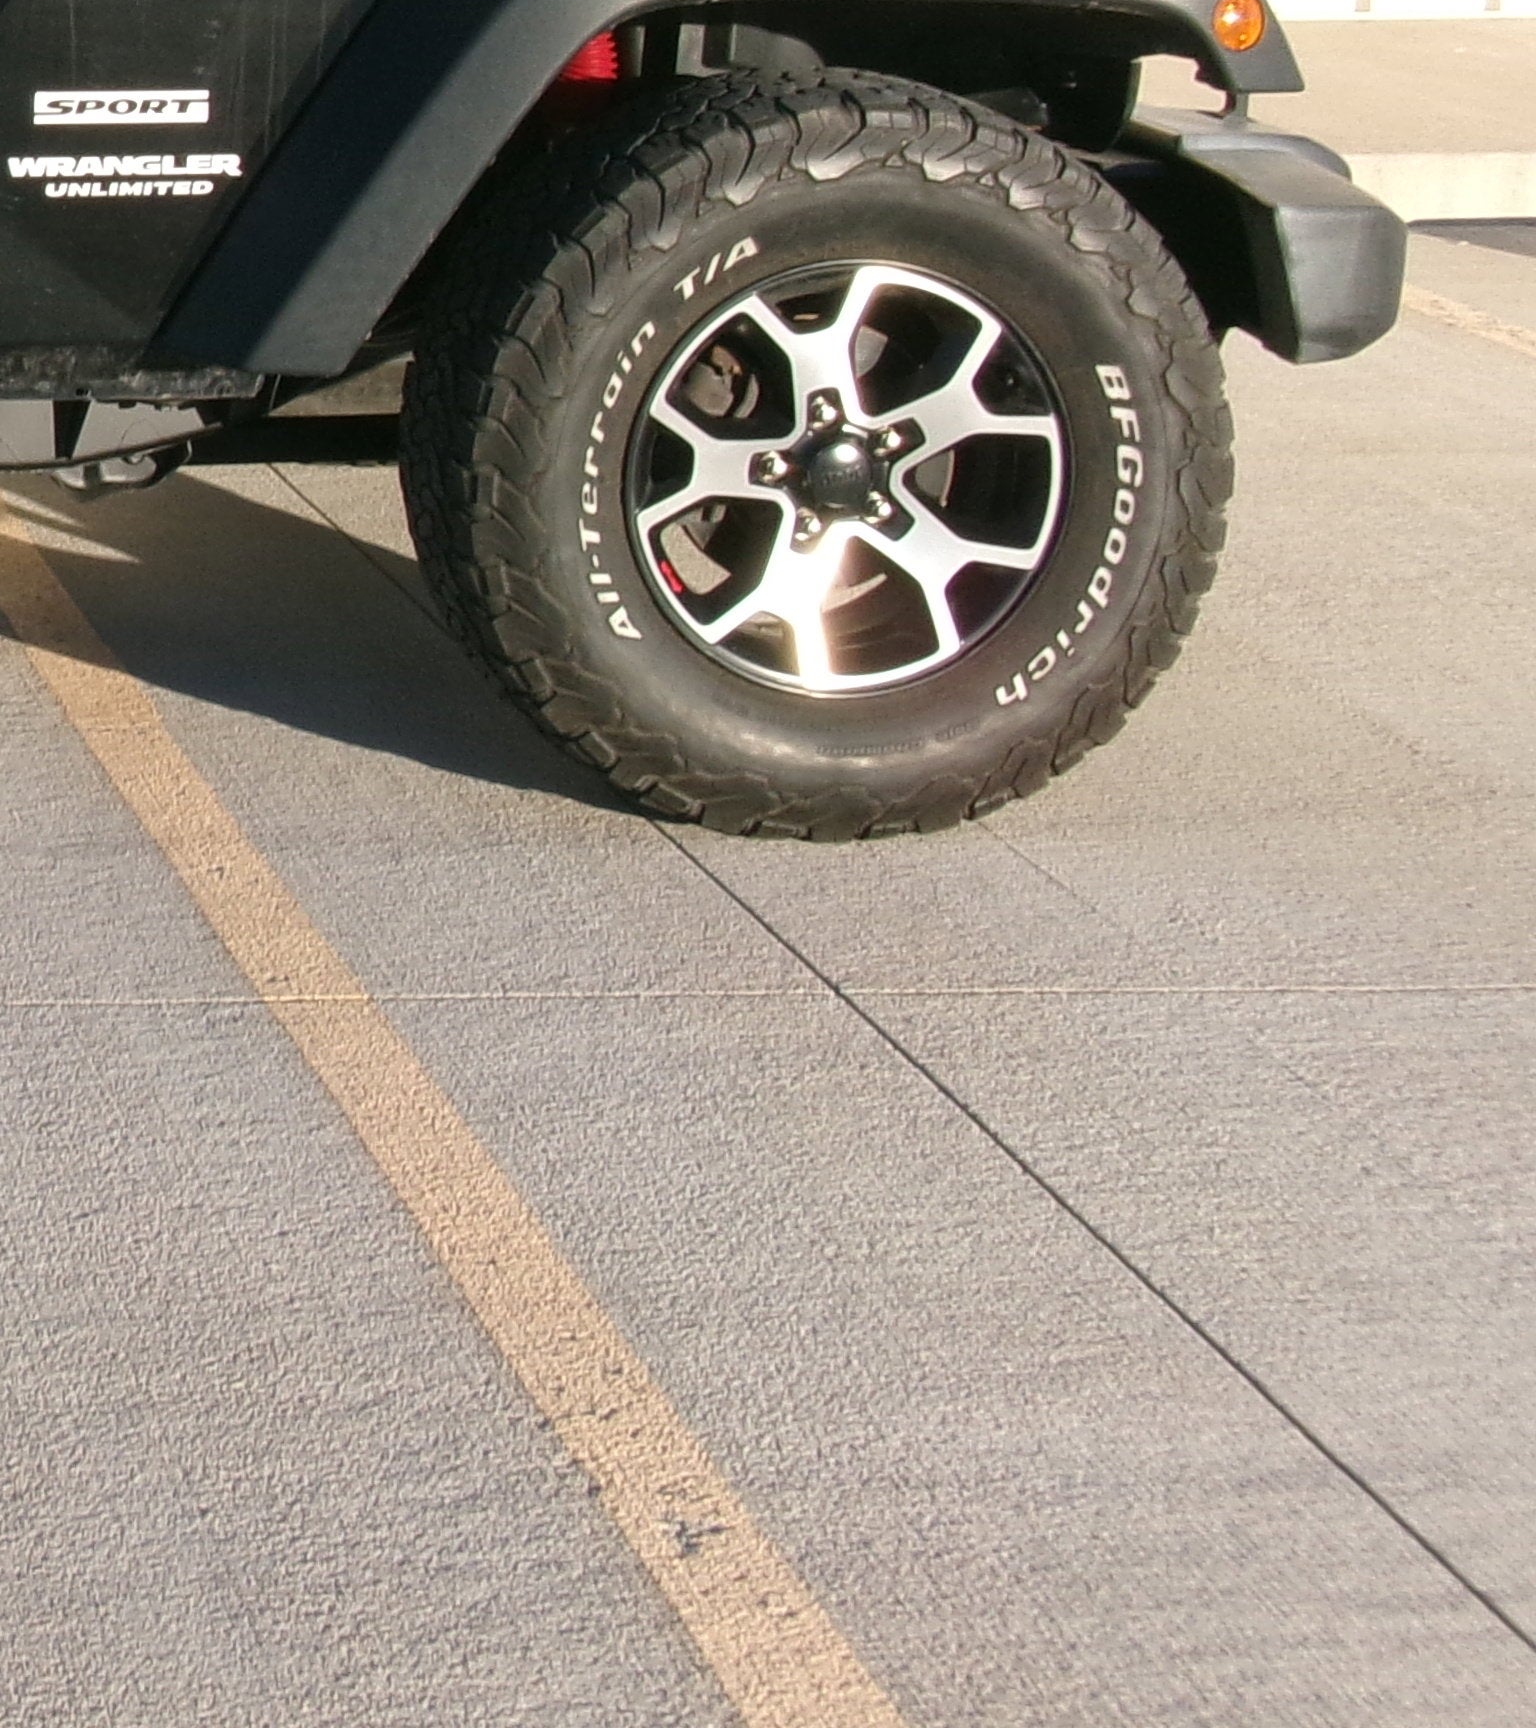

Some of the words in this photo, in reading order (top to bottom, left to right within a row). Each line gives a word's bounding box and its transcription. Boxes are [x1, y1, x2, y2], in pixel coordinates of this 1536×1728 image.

[39, 96, 206, 117] SPORT
[7, 153, 243, 177] WRANGLER
[44, 180, 214, 198] UNLIMITED
[579, 320, 657, 643] All-Terrain
[672, 235, 761, 302] T/A
[994, 362, 1146, 708] BFGoodrich
